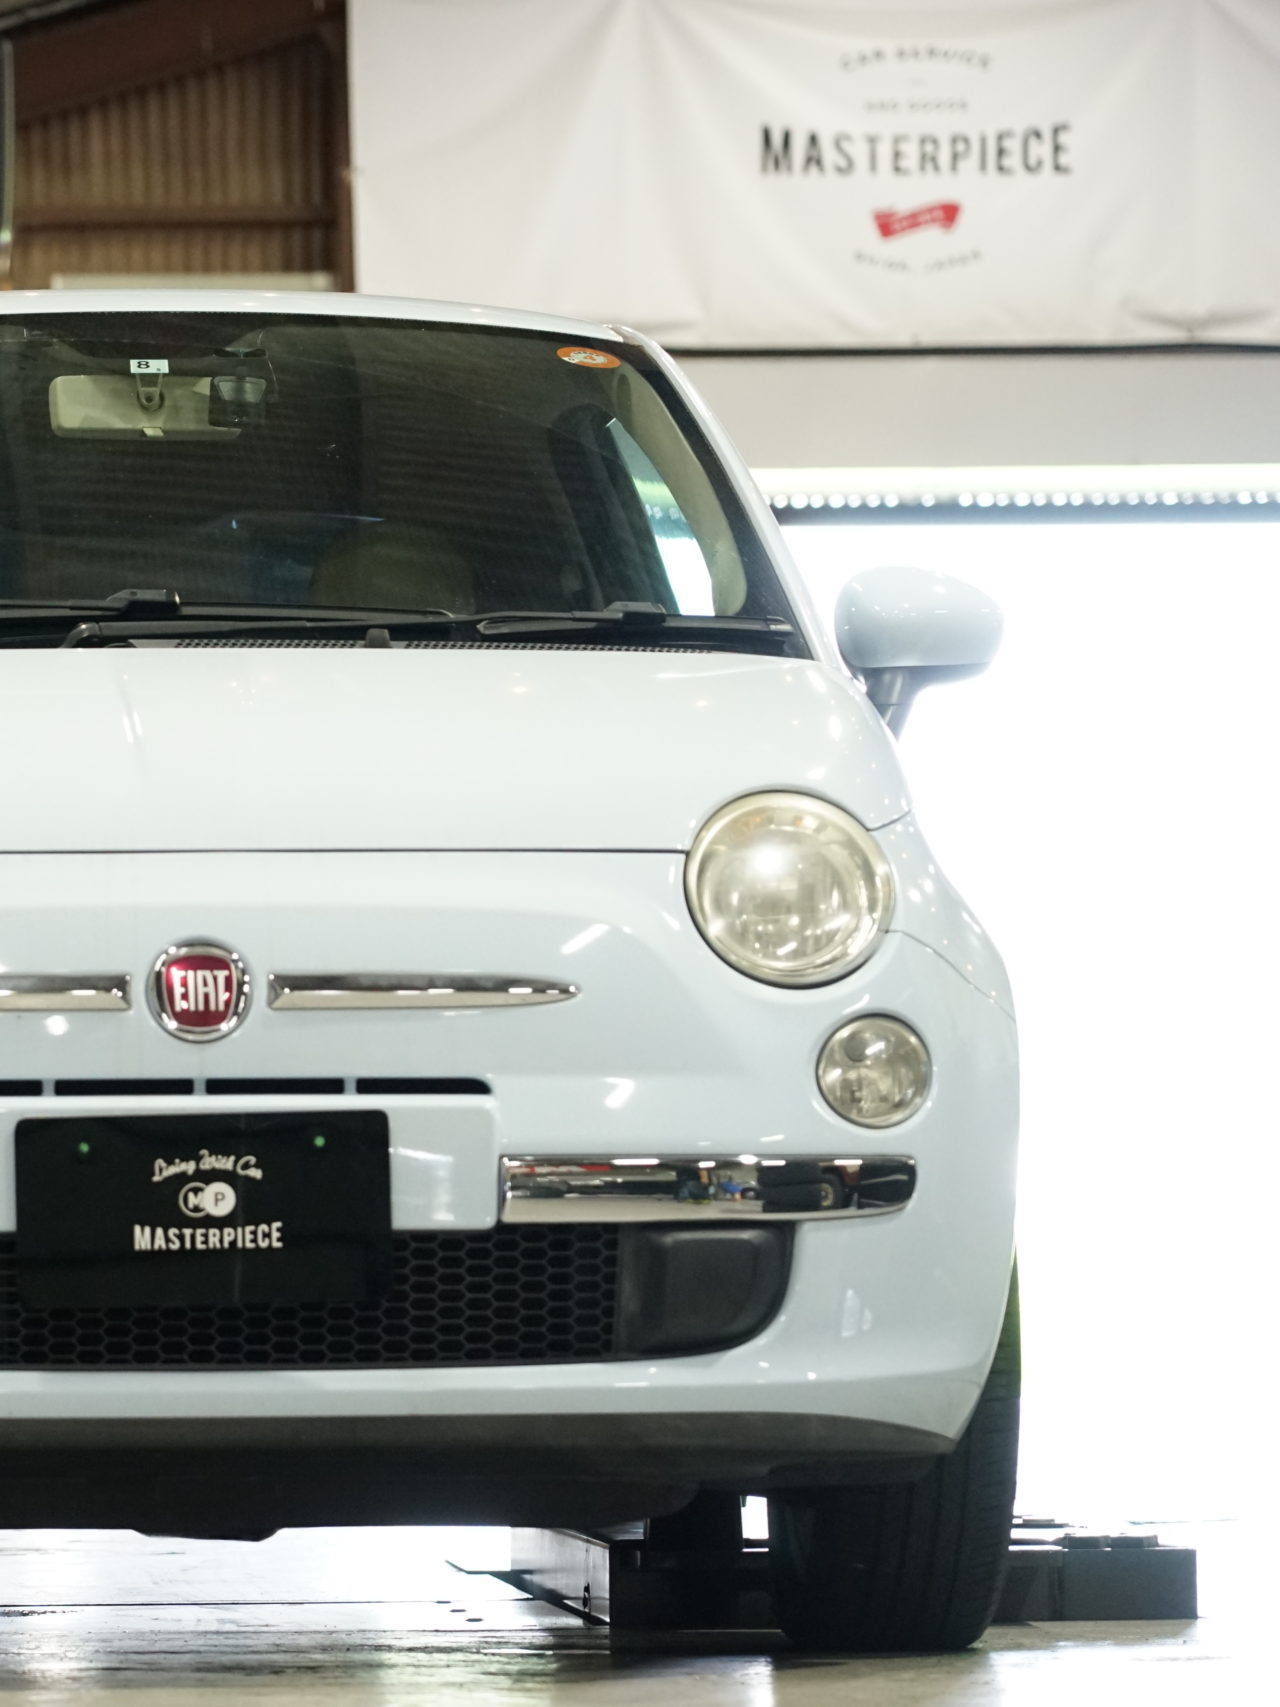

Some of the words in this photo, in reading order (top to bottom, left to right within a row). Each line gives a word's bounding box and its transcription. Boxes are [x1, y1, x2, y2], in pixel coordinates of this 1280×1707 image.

[759, 122, 1073, 176] MASTERPIECE
[136, 360, 150, 369] 8
[171, 967, 230, 1012] FIAT
[133, 1221, 283, 1251] MASTERPIECE
